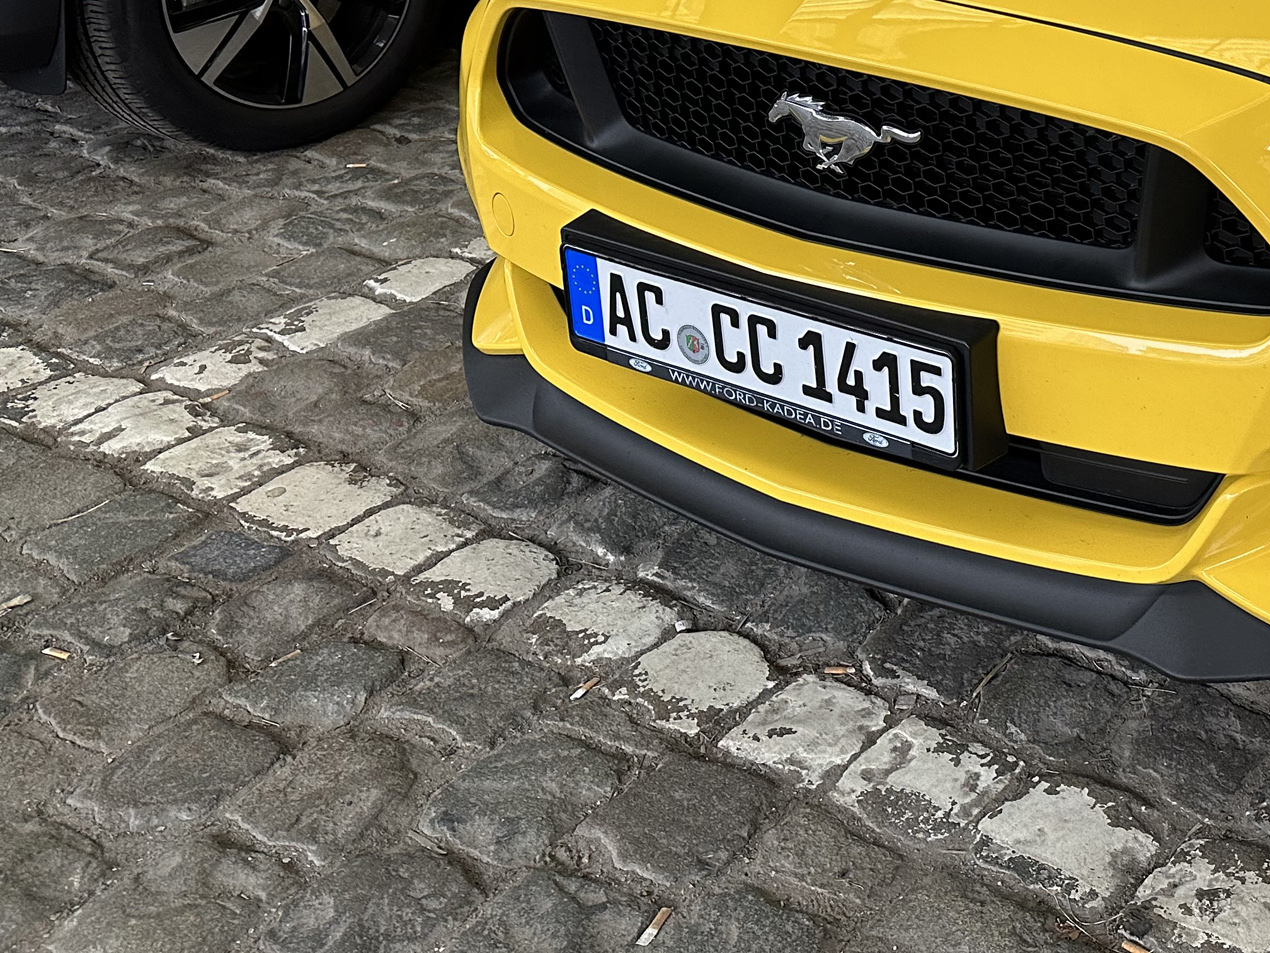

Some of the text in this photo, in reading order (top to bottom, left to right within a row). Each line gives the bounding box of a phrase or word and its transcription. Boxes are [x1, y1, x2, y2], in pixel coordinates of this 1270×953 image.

[581, 304, 594, 325] D
[608, 272, 671, 351] AC
[710, 303, 783, 385] CC
[797, 330, 945, 435] 1415
[668, 368, 843, 435] WWW.FORD-KADEA.DE
